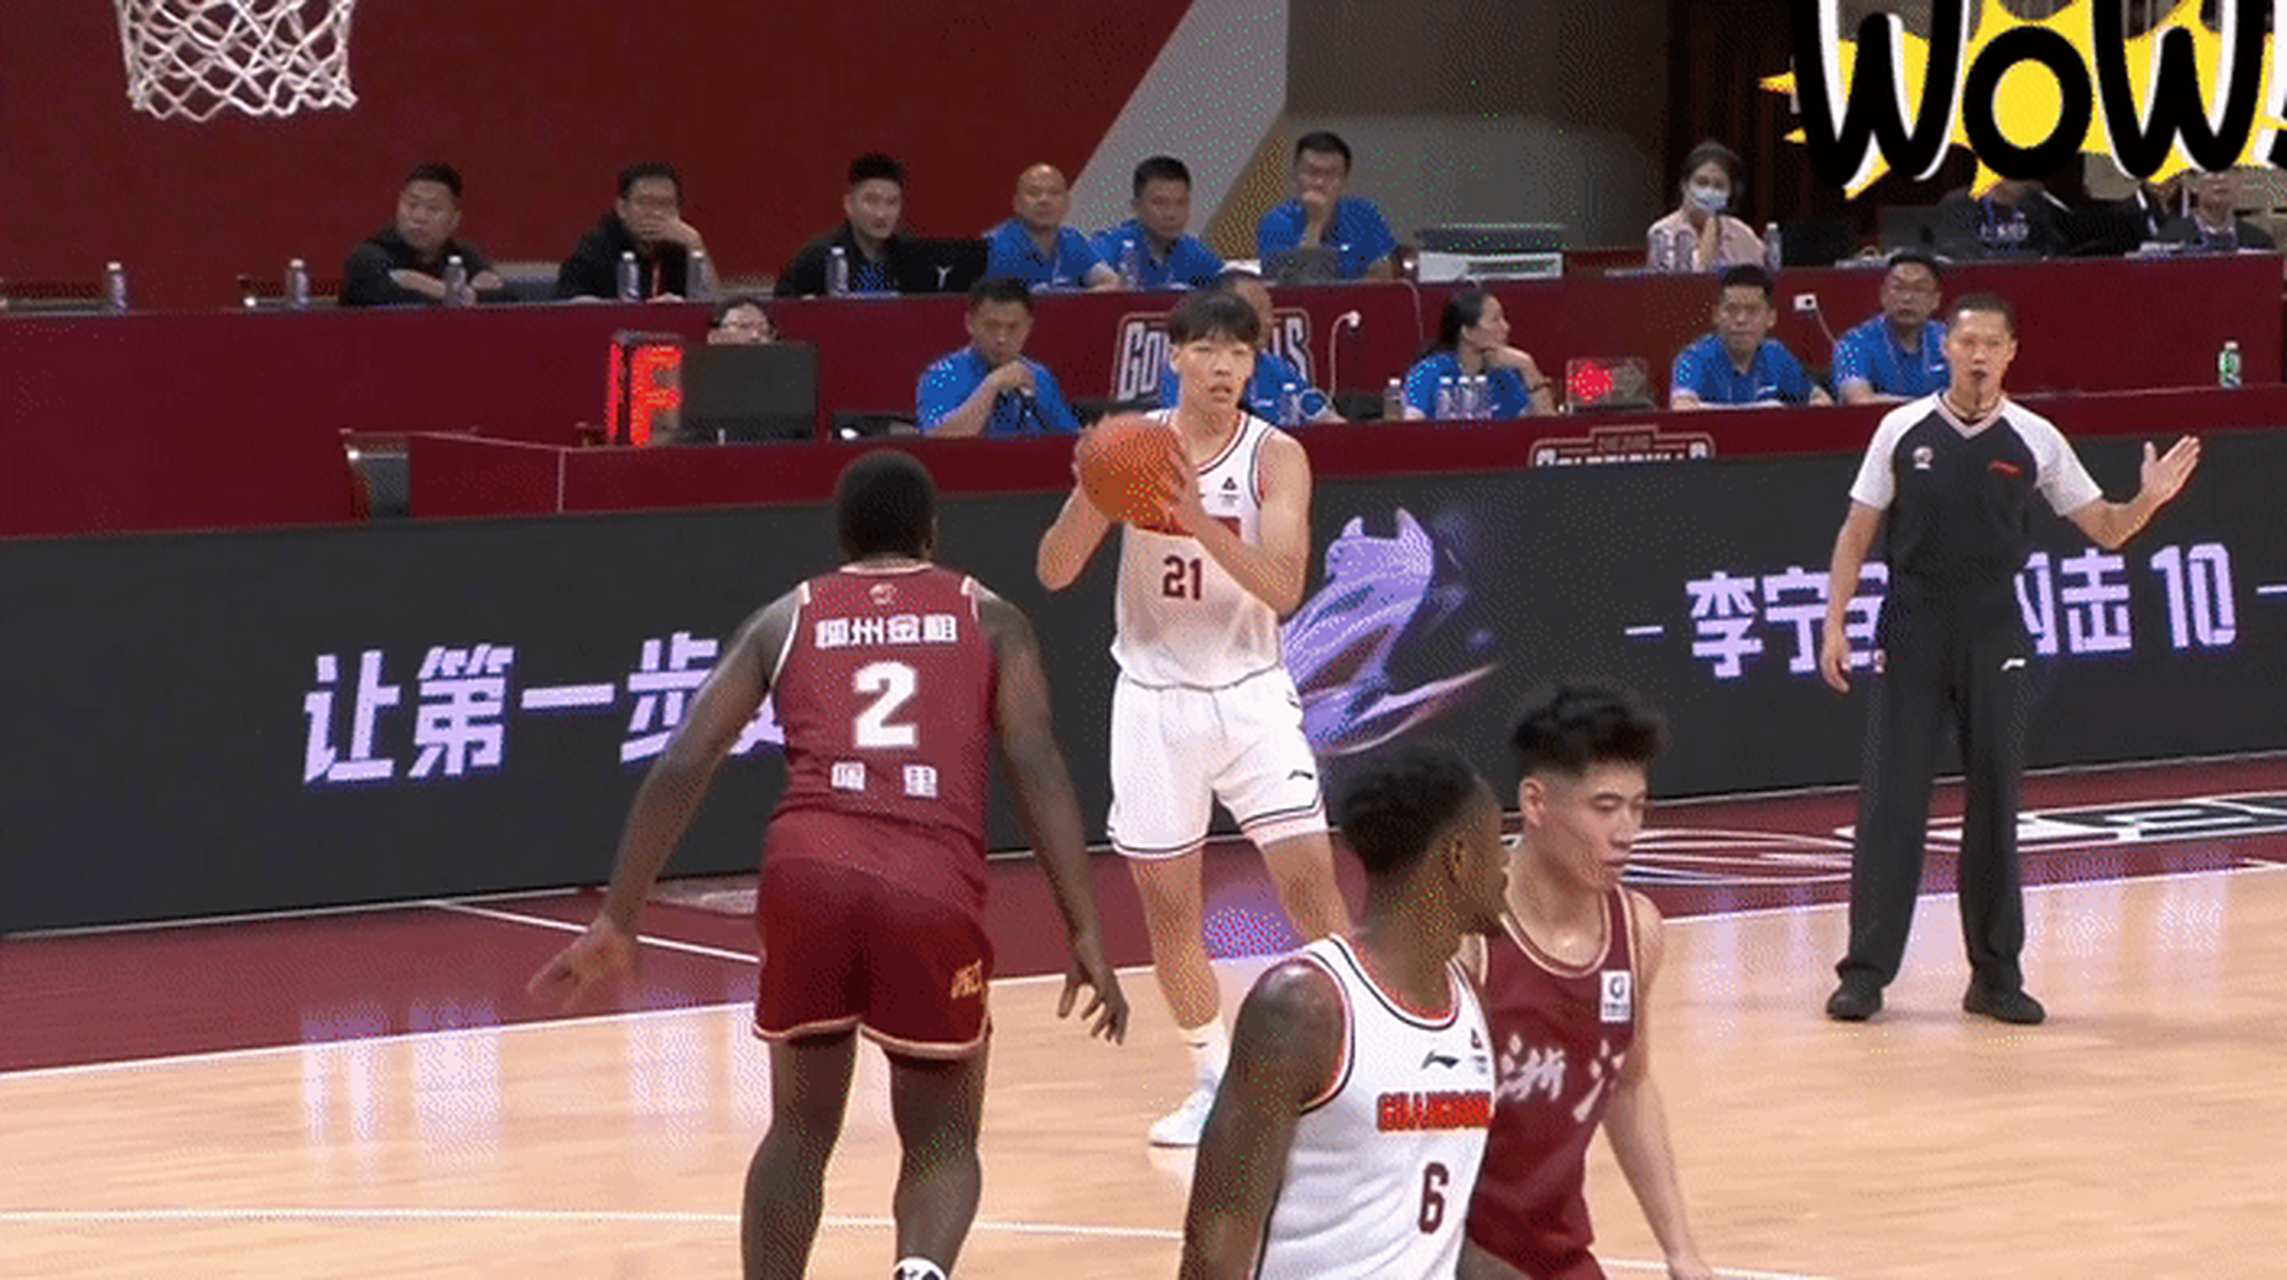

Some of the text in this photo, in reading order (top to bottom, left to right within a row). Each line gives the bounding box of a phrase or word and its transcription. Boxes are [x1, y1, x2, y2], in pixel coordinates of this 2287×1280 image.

[1163, 555, 1201, 600] 21
[2150, 543, 2236, 647] 10
[303, 631, 786, 784] 让第一步
[854, 661, 918, 748] 2
[1418, 1161, 1449, 1235] 6
